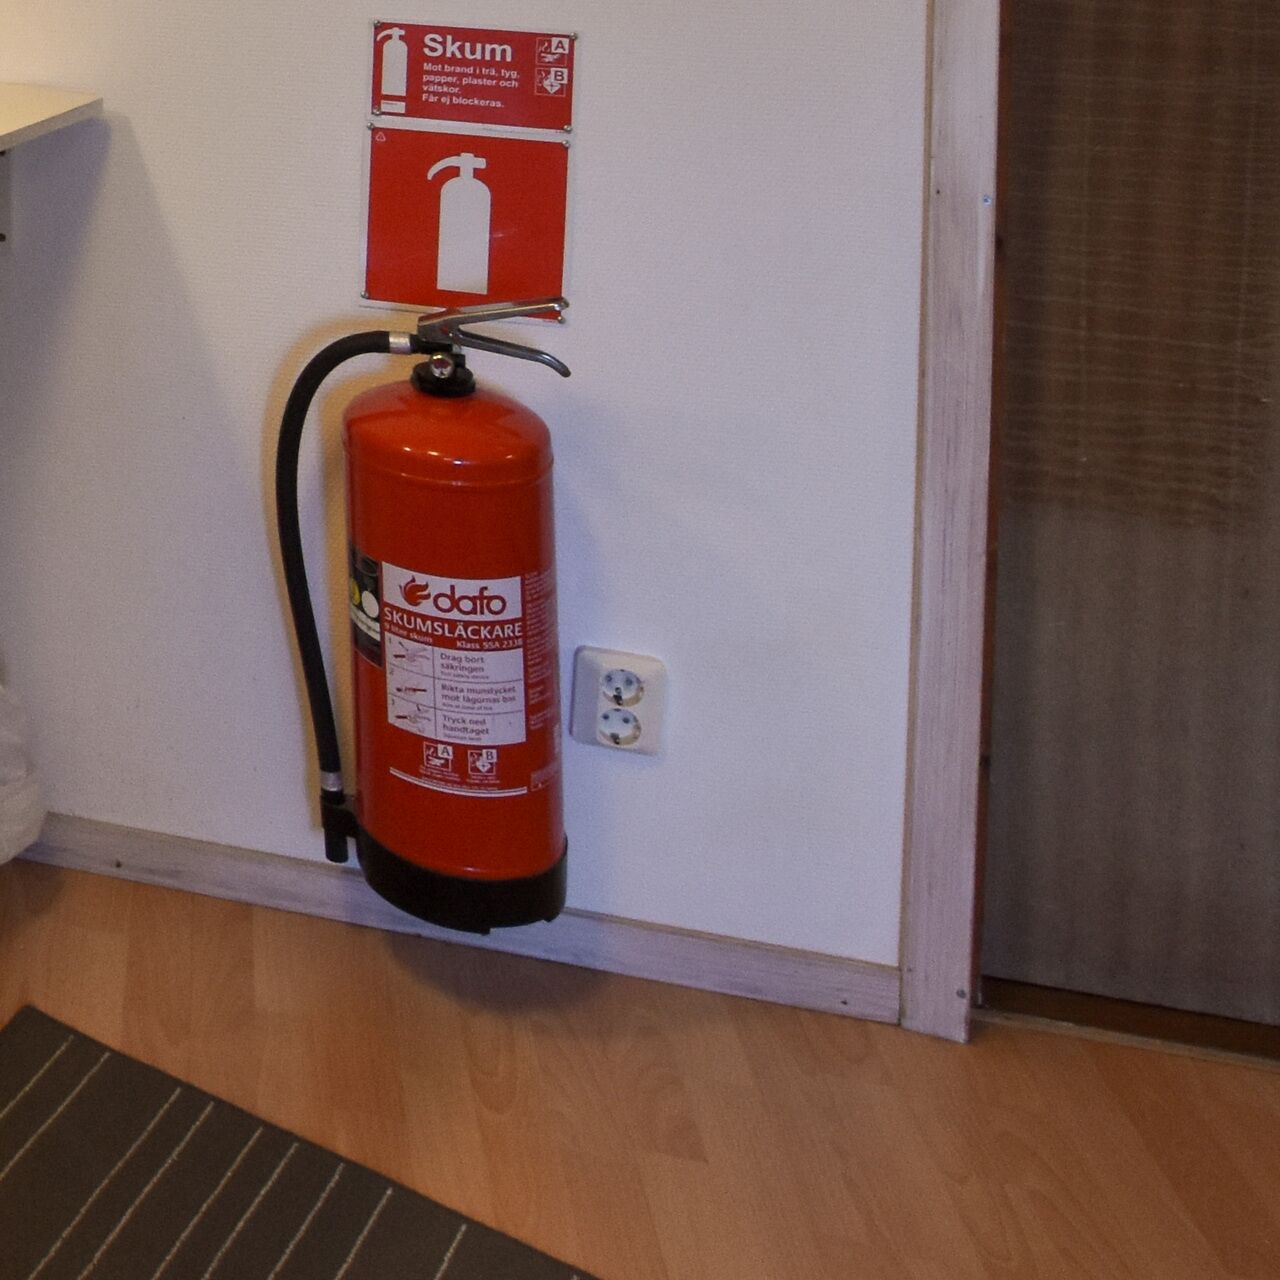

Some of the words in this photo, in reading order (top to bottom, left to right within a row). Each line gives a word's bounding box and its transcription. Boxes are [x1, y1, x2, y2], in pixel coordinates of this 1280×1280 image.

[423, 34, 512, 62] Skum
[554, 40, 566, 52] A
[423, 62, 442, 72] Mot
[444, 65, 474, 74] brand
[462, 76, 496, 87] plaster
[499, 78, 518, 88] och
[554, 71, 565, 82] B
[422, 84, 462, 94] vätskor.
[422, 92, 439, 102] Får
[441, 95, 450, 105] ej
[452, 96, 505, 108] blockeras.
[433, 584, 506, 615] dafo
[383, 606, 523, 640] SKUMSLÄCKARE
[409, 632, 433, 644] skum
[456, 639, 481, 650] Klass
[440, 652, 462, 664] Drag
[465, 654, 484, 663] bort
[440, 662, 485, 674] säkringen
[441, 683, 464, 694] Rikta
[441, 694, 460, 702] mot
[502, 694, 516, 702] bas
[442, 714, 466, 727] Tryck
[469, 718, 487, 726] ned
[443, 724, 490, 736] handtaget
[441, 746, 450, 757] A
[486, 750, 494, 761] B
